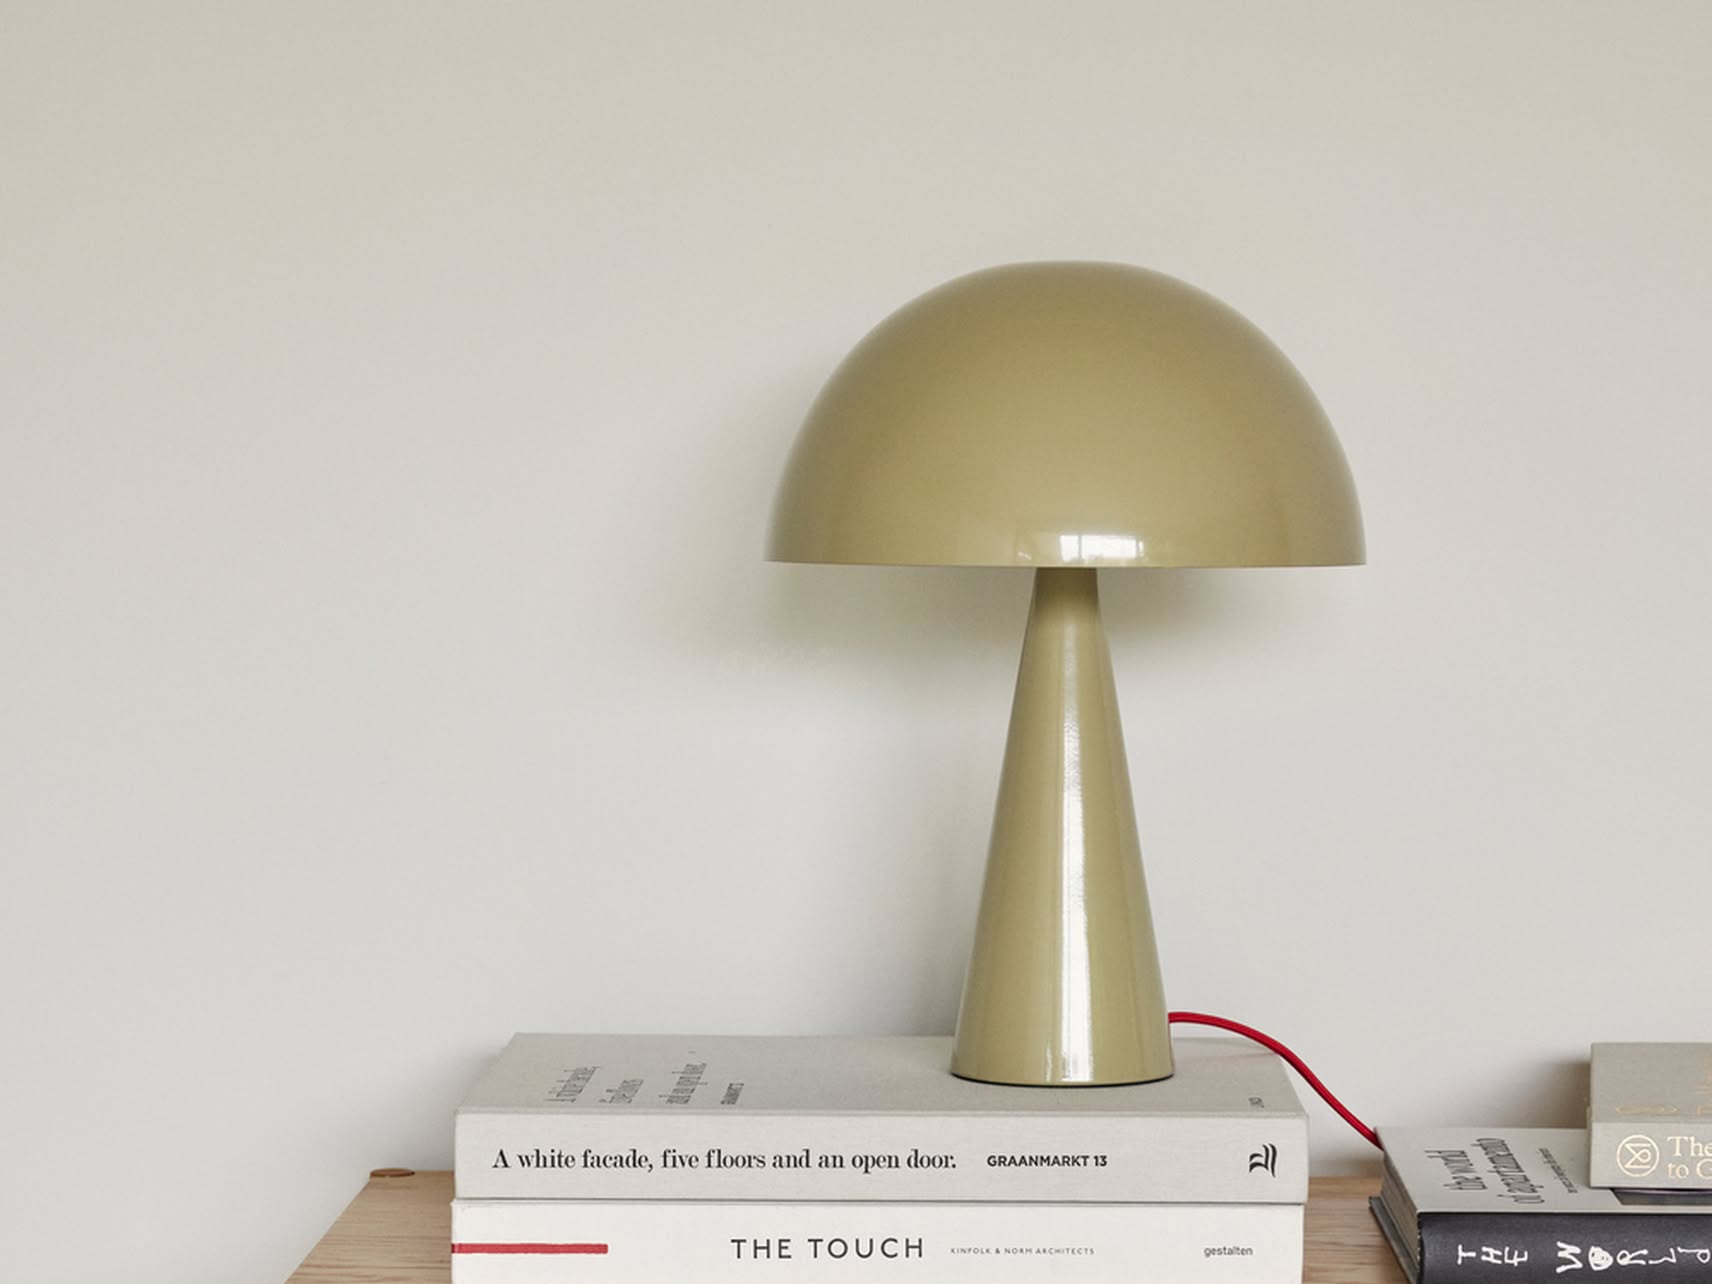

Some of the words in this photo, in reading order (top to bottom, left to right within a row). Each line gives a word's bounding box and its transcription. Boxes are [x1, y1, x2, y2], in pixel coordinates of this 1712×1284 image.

[1666, 1136, 1712, 1157] The
[492, 1149, 511, 1169] A
[517, 1149, 576, 1169] white
[580, 1149, 654, 1173] facade,
[661, 1149, 699, 1169] five
[704, 1149, 766, 1169] floors
[772, 1149, 811, 1169] and
[818, 1154, 845, 1169] an
[850, 1154, 900, 1174] open
[906, 1149, 957, 1169] door.
[986, 1155, 1089, 1168] GRAANMARKT
[1093, 1155, 1107, 1168] 13
[1667, 1162, 1690, 1179] to
[730, 1238, 793, 1259] THE
[807, 1238, 924, 1259] TOUCH
[950, 1247, 992, 1255] KINFOLK
[1004, 1247, 1033, 1255] NORM
[1035, 1247, 1095, 1256] ARCHITECTS
[1203, 1246, 1254, 1259] gestalten
[1457, 1244, 1528, 1266] THE
